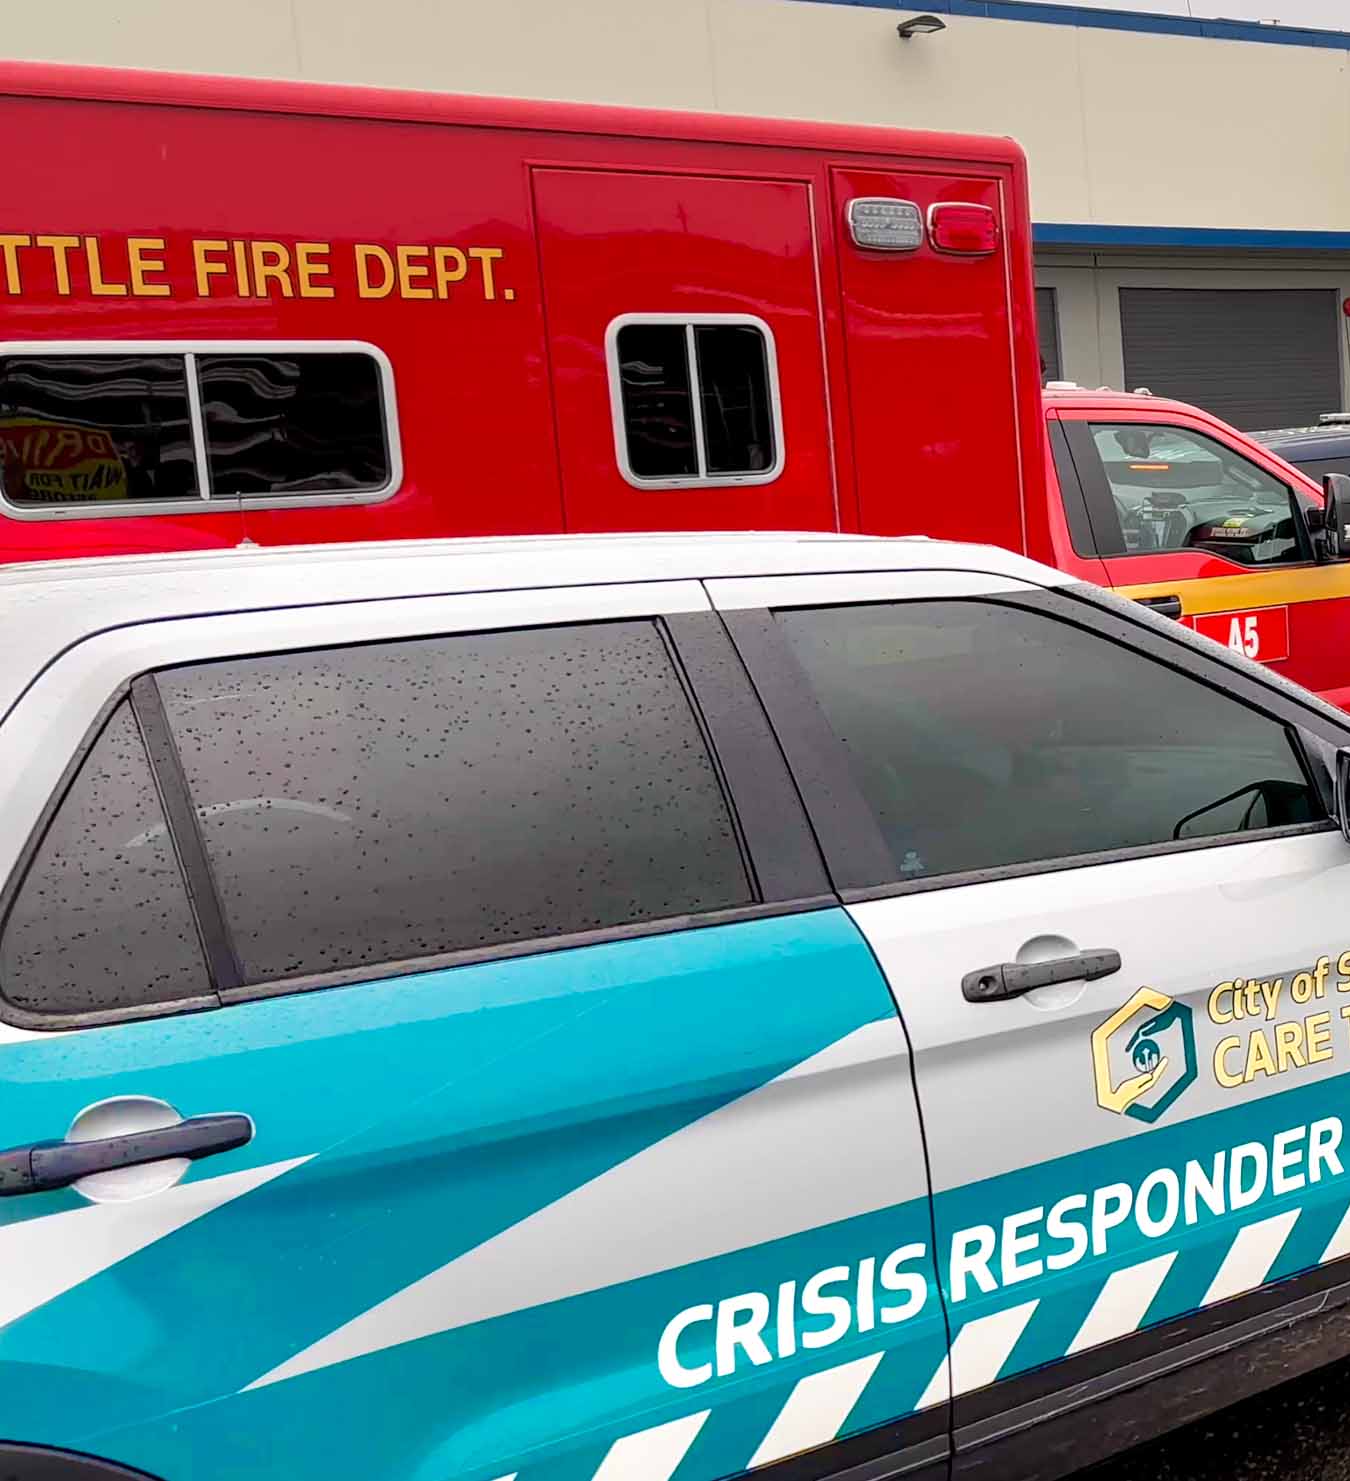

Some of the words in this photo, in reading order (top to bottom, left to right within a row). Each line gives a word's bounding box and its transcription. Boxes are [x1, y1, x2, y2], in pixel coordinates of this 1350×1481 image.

[0, 234, 171, 297] TTLE
[192, 239, 336, 298] FIRE
[354, 243, 516, 301] DEPT.
[1228, 616, 1259, 658] A5
[1207, 979, 1284, 1025] City
[1291, 955, 1331, 1004] of
[1212, 1012, 1335, 1089] CARE
[656, 1242, 928, 1390] CRISIS
[948, 1115, 1345, 1304] RESPONDER
